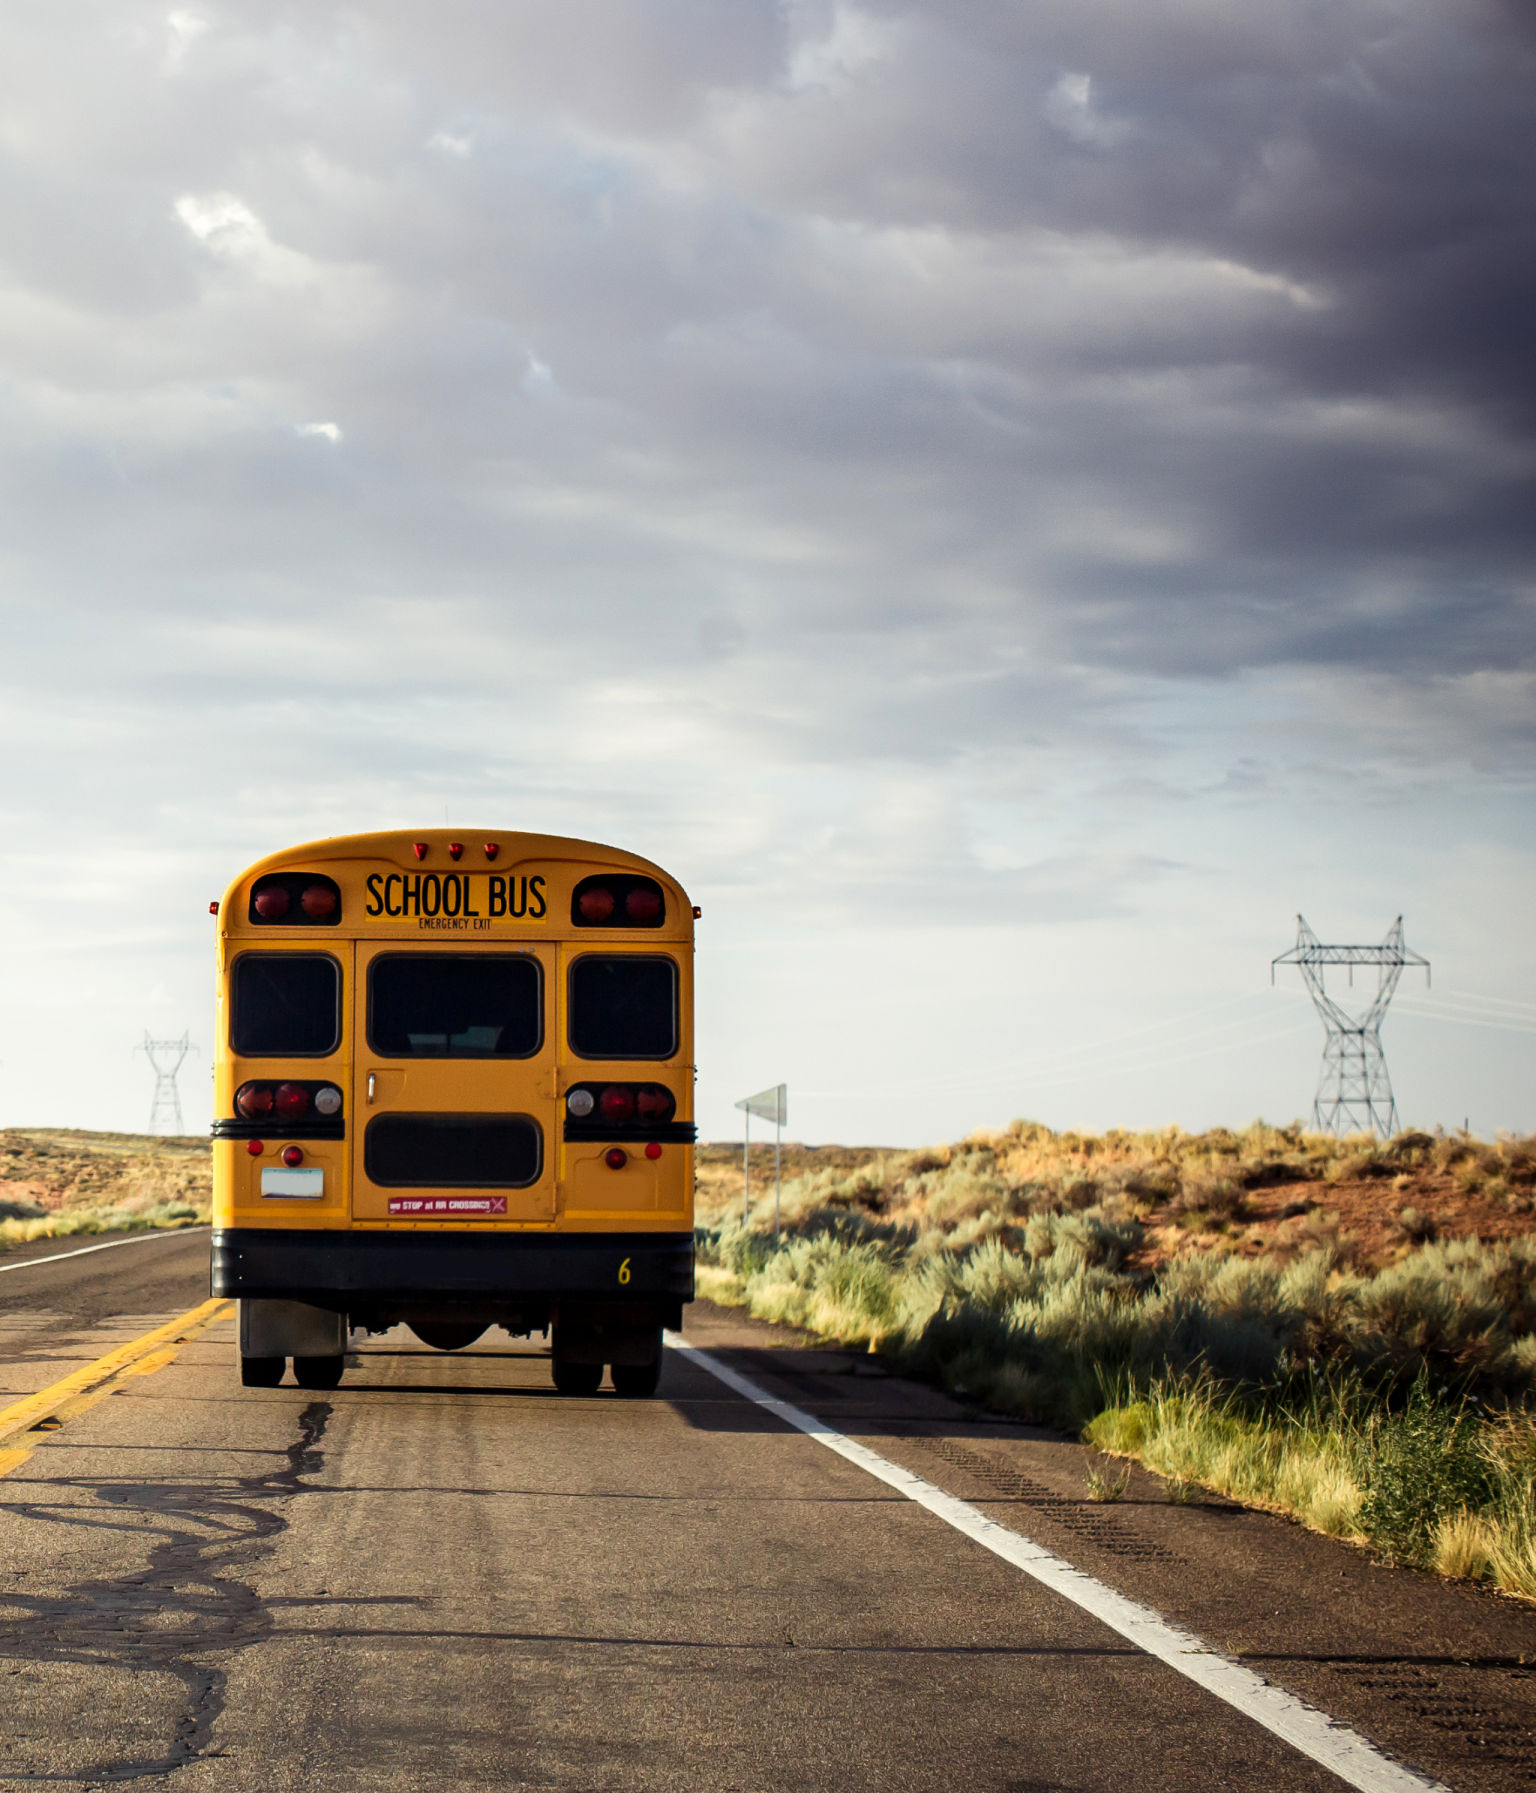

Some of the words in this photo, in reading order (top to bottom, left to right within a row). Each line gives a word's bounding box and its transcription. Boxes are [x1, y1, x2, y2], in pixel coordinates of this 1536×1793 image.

[366, 873, 479, 916] SCHOOL
[489, 875, 547, 918] BUS
[418, 918, 469, 929] EMERGENCY
[473, 918, 492, 930] EXIT
[402, 1201, 423, 1210] STOP
[618, 1257, 631, 1285] 6
